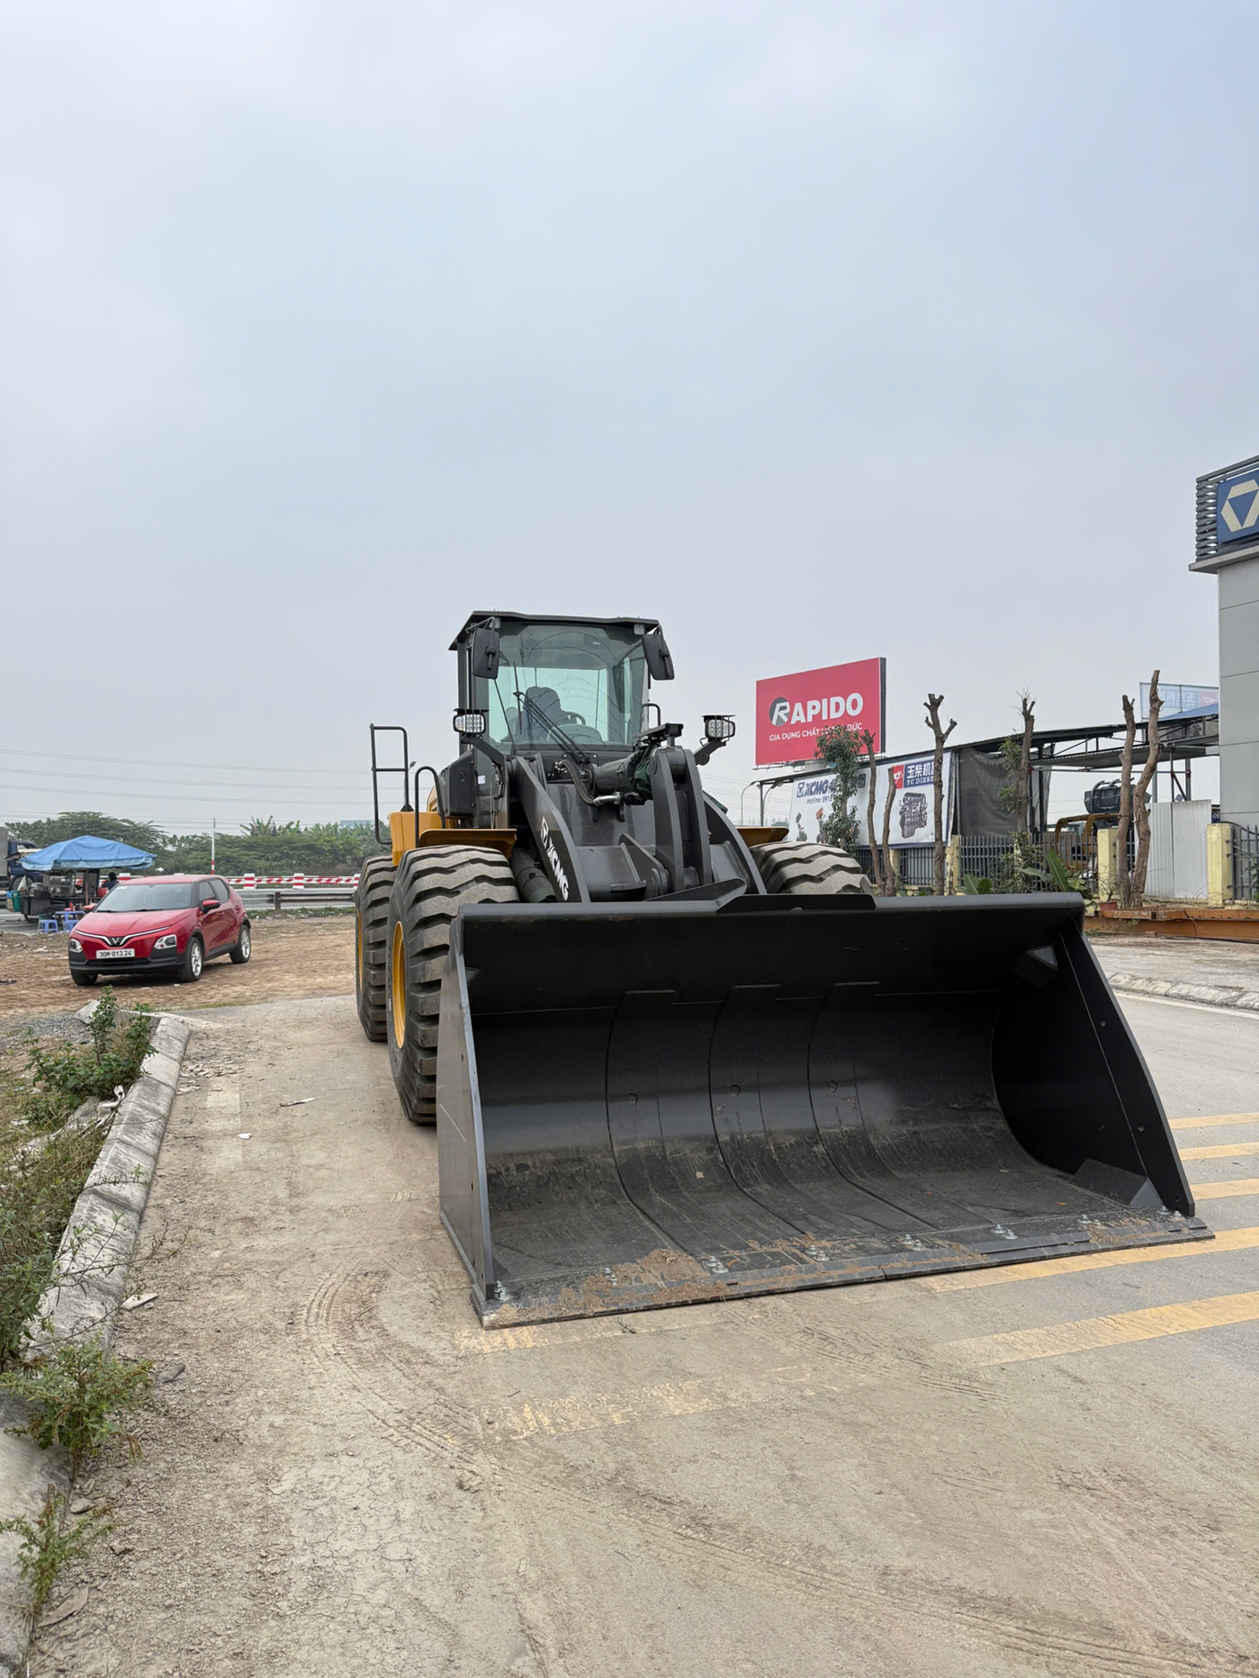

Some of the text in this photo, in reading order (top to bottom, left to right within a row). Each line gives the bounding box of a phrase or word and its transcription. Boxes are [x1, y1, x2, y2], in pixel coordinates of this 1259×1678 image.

[771, 692, 864, 726] RAPIDO
[769, 733, 780, 742] GIA
[546, 836, 569, 901] XCMG
